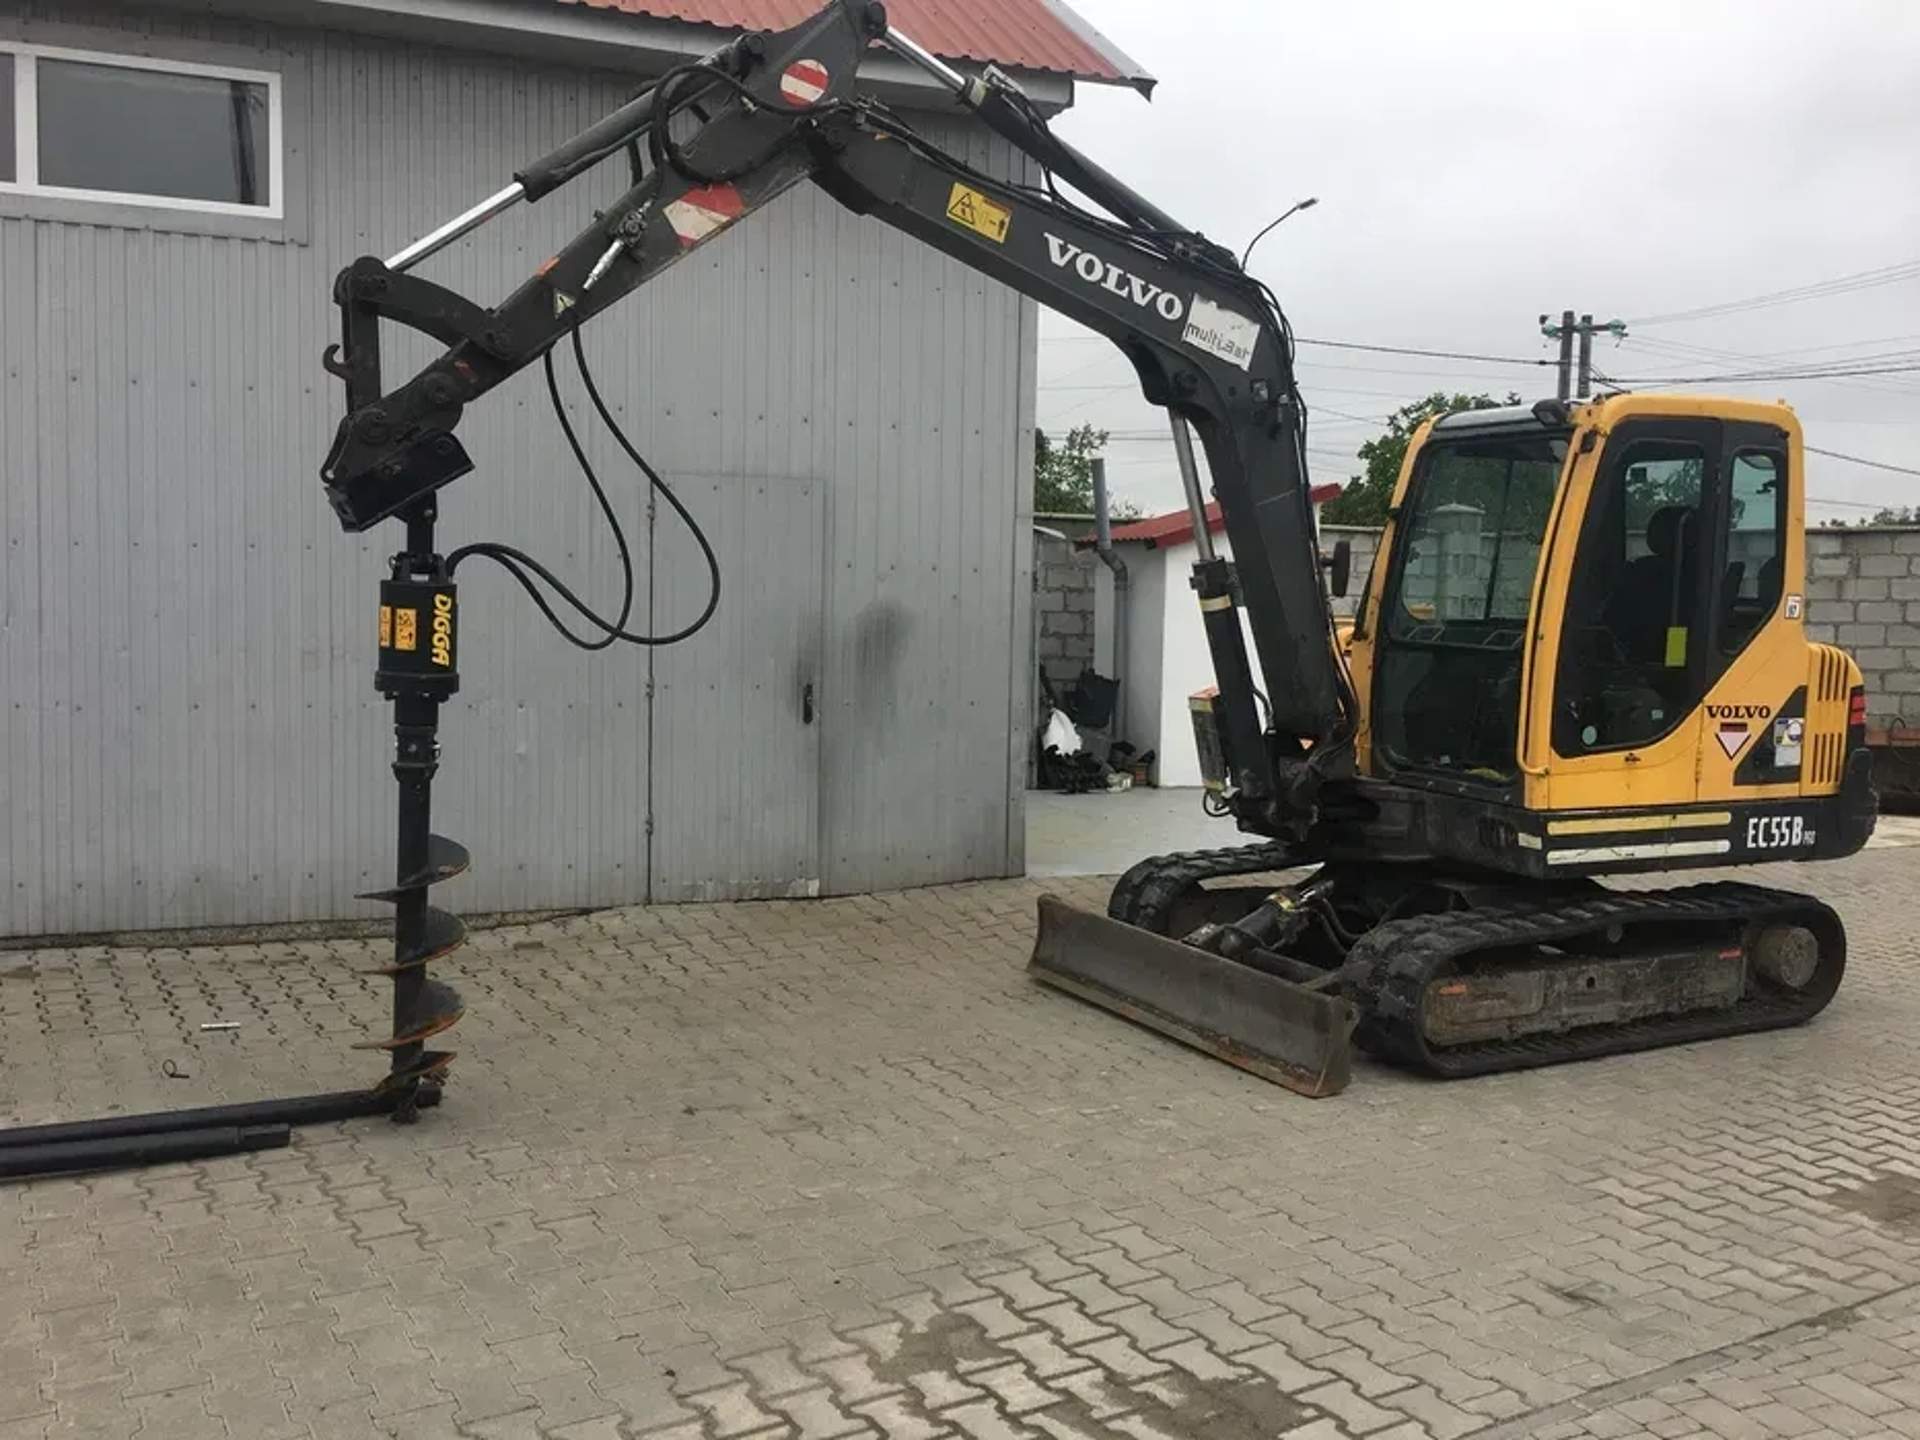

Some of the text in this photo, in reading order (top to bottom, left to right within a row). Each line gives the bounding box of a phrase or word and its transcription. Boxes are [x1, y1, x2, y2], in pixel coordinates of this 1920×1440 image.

[1043, 232, 1183, 321] VOLVO
[432, 593, 452, 667] DIGGA
[1706, 704, 1771, 719] VOLVO
[1747, 815, 1804, 849] EC55B
